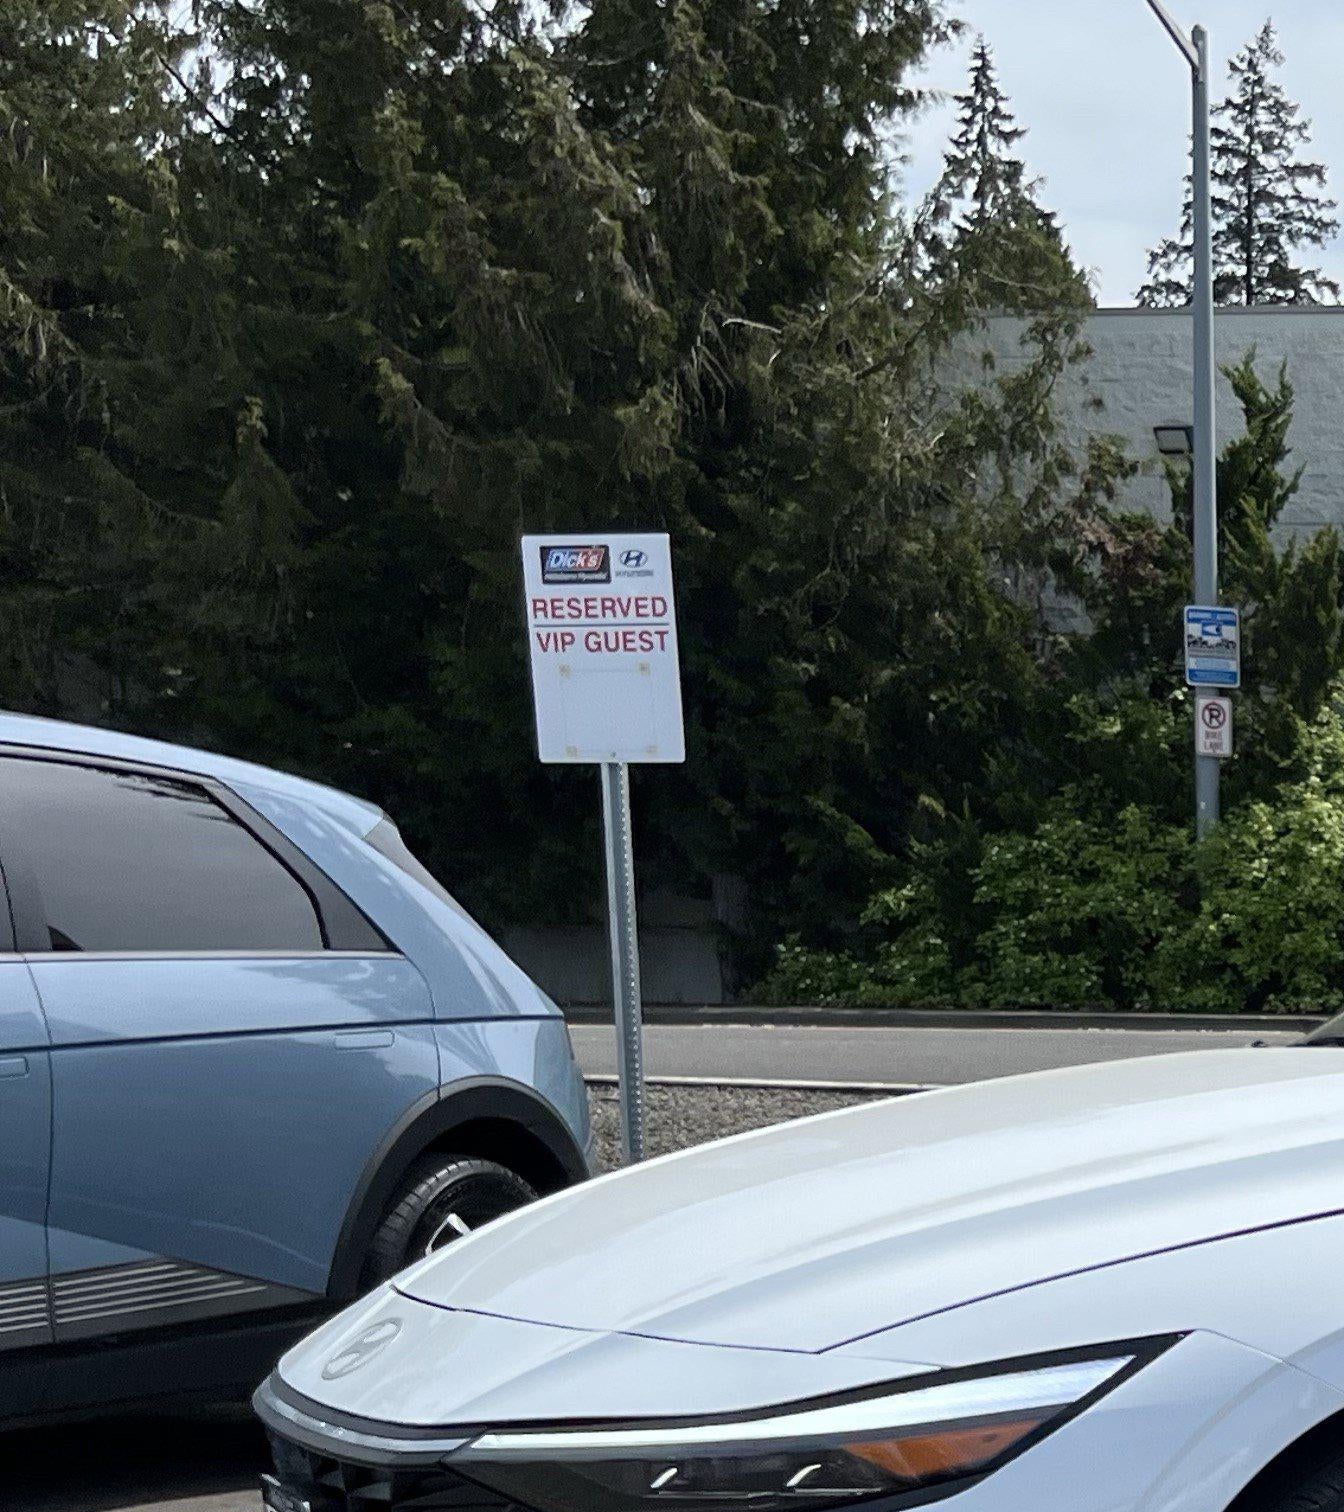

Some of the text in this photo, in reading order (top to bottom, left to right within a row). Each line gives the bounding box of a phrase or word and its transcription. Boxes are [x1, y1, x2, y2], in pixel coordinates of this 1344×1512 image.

[532, 597, 669, 619] RESERVED
[536, 630, 669, 653] VIP GUEST
